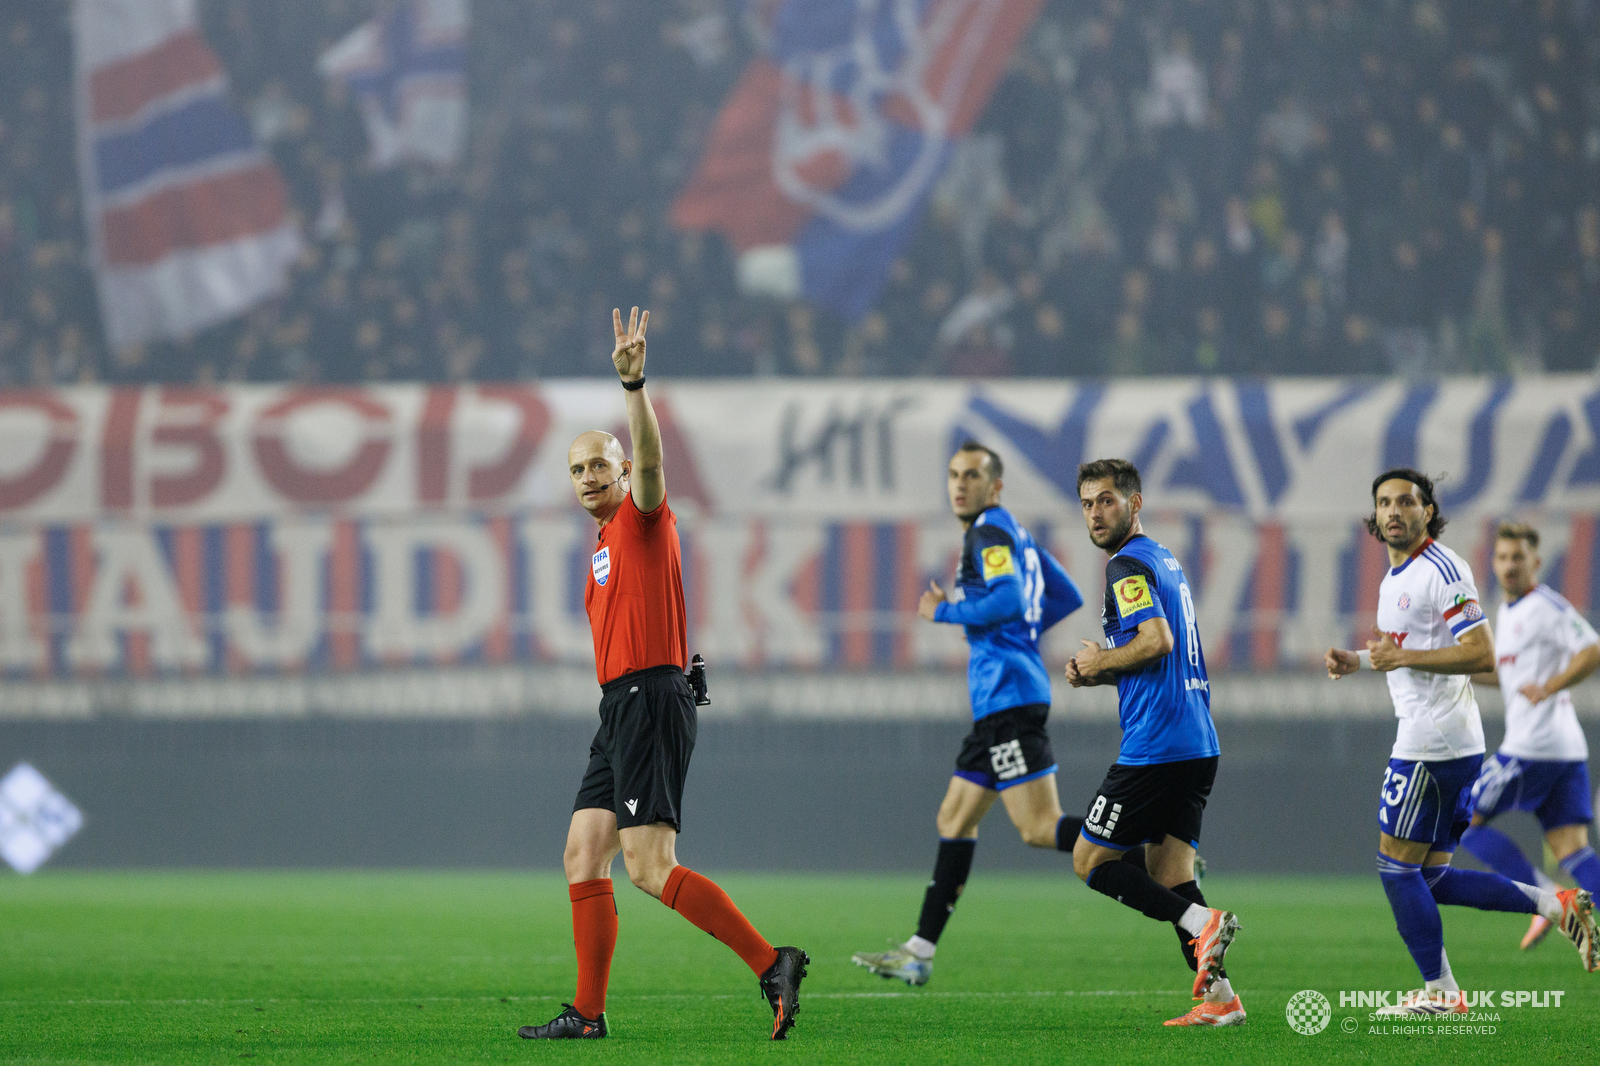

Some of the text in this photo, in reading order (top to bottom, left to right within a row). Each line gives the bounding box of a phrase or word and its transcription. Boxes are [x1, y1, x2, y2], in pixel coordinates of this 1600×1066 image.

[593, 551, 608, 564] FIFA
[1121, 600, 1152, 616] GERMANIA
[1380, 766, 1408, 807] 23
[1088, 794, 1107, 824] 8
